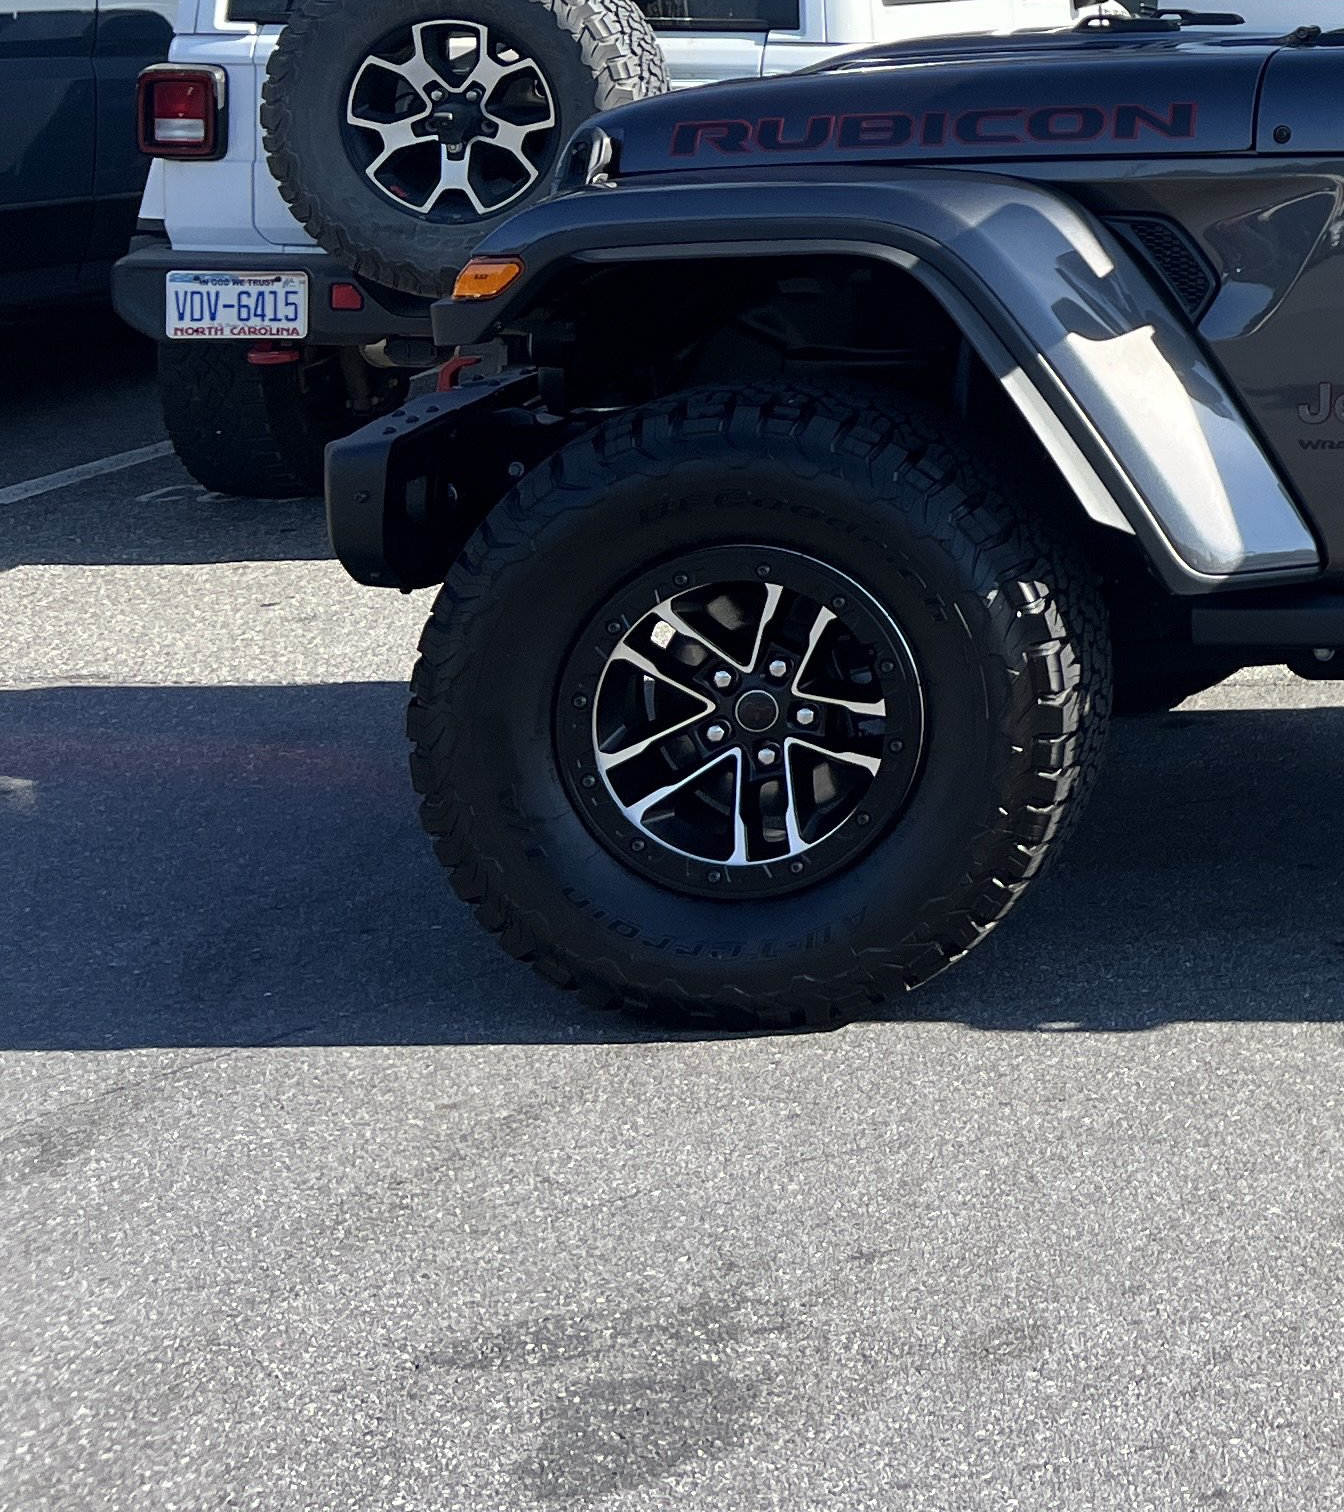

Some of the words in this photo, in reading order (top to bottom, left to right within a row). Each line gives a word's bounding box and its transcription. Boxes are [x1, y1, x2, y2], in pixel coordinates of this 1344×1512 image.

[669, 101, 1198, 157] RUBICON
[173, 326, 224, 336] NORTH
[230, 326, 300, 336] CAROLINA
